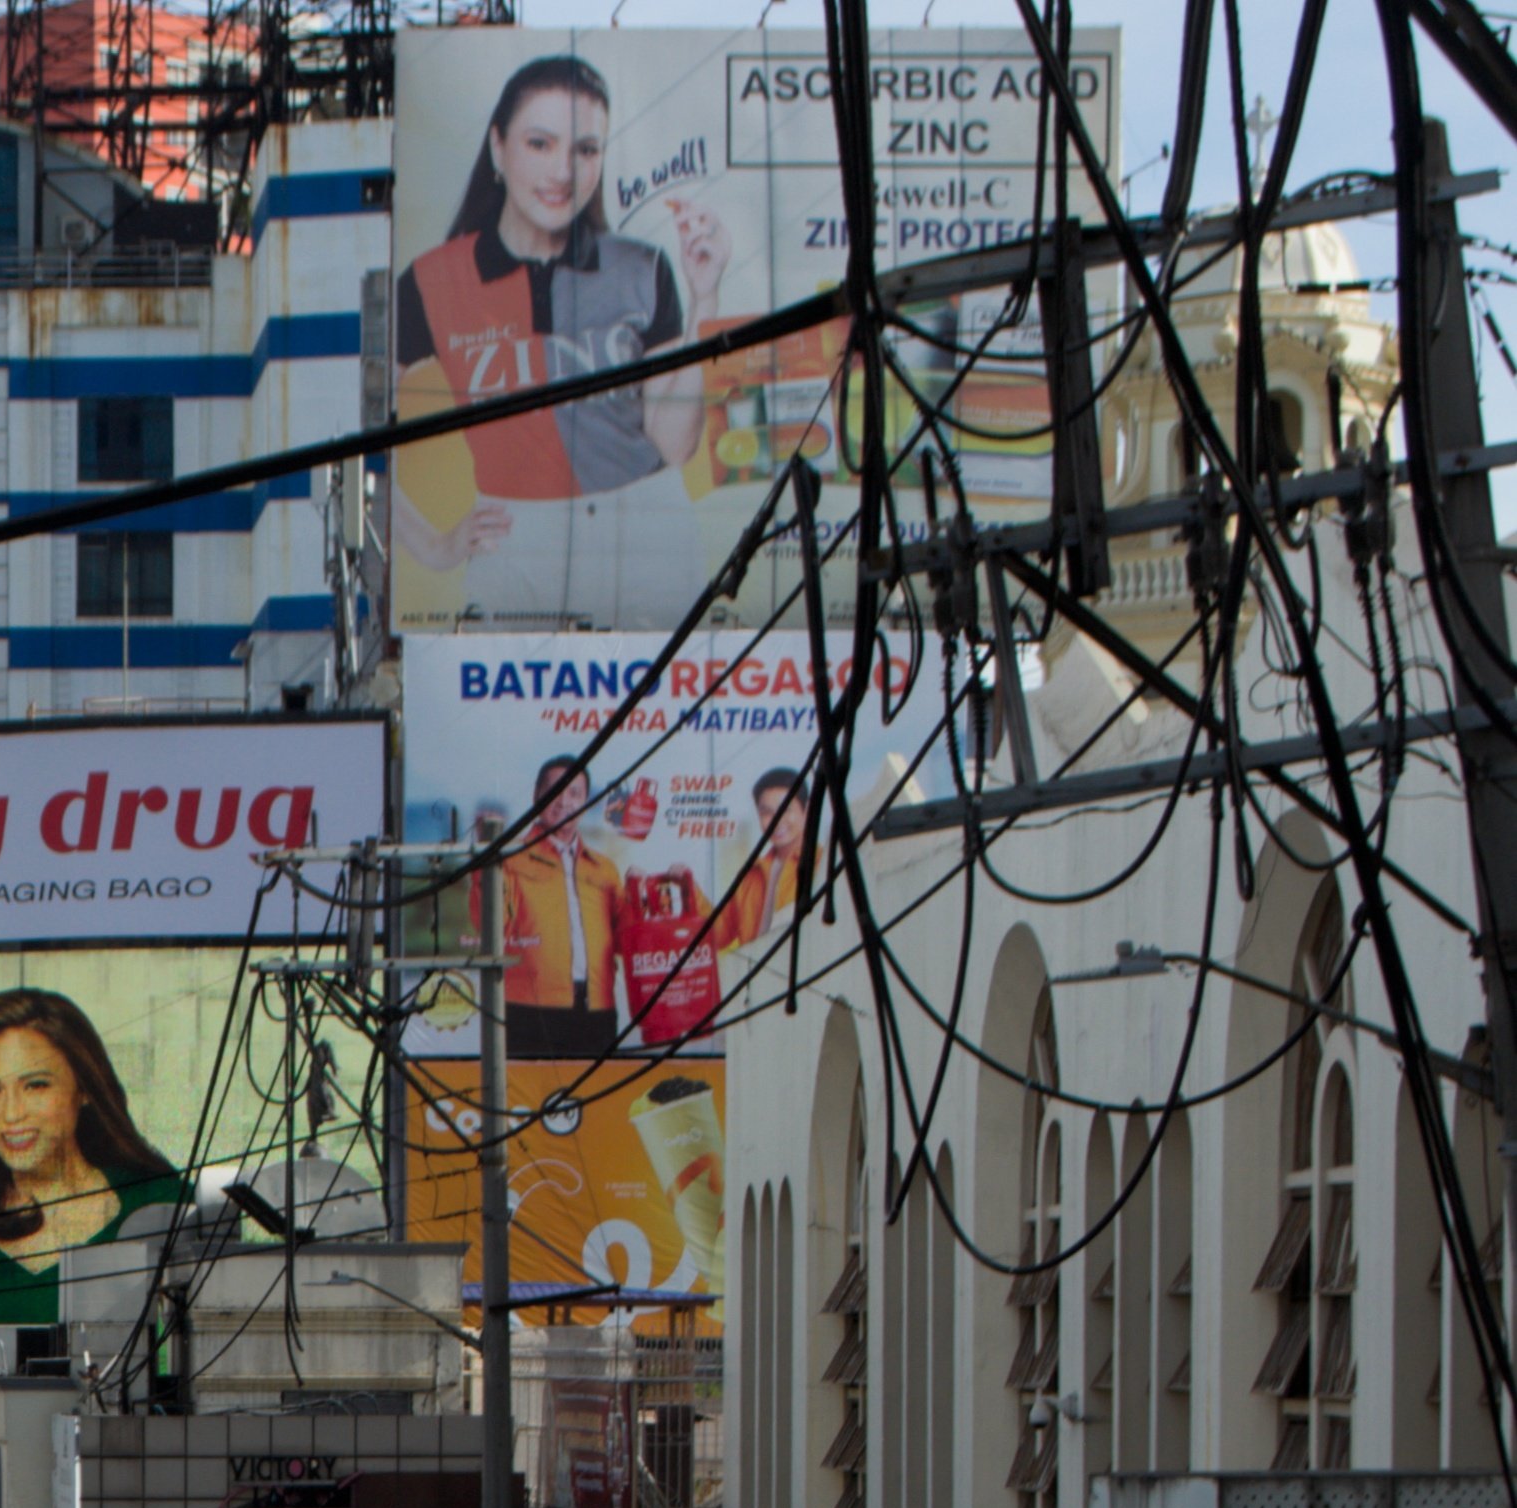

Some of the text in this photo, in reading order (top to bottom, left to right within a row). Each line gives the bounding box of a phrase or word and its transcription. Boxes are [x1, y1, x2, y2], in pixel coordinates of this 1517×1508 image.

[741, 67, 1099, 102] ASCRBIC ACD
[888, 120, 990, 155] ZINC
[618, 137, 707, 208] be well!
[670, 774, 733, 792] SWAP
[678, 820, 736, 839] FREE!
[108, 876, 212, 900] BAGO
[228, 1456, 338, 1480] VICTORY
